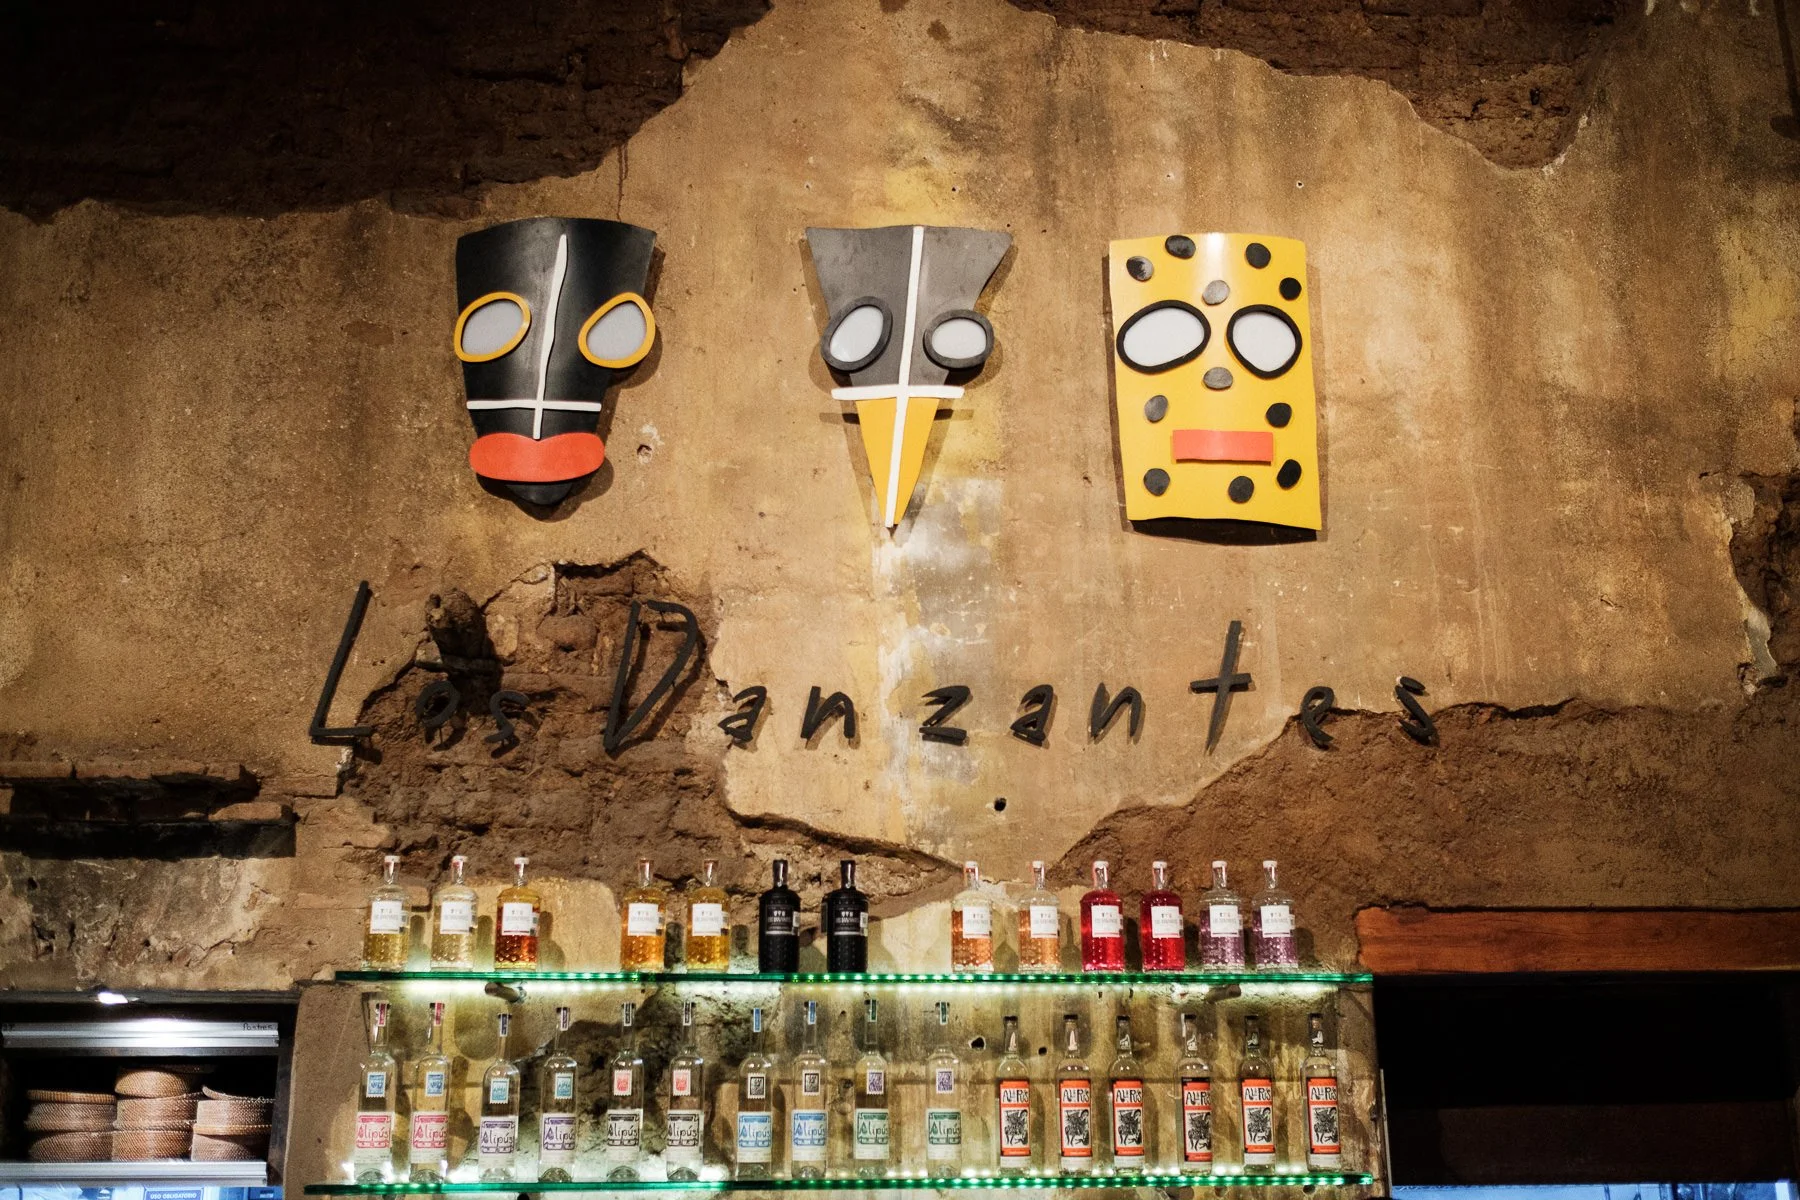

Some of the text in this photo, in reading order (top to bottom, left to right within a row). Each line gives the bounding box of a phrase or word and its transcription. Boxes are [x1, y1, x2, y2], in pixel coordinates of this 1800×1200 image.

[309, 580, 1440, 757] Los Danzantes
[357, 1123, 390, 1142] Alipús
[482, 1129, 515, 1148] Alipús
[607, 1122, 639, 1141] Alipús
[667, 1122, 698, 1141] Alipús
